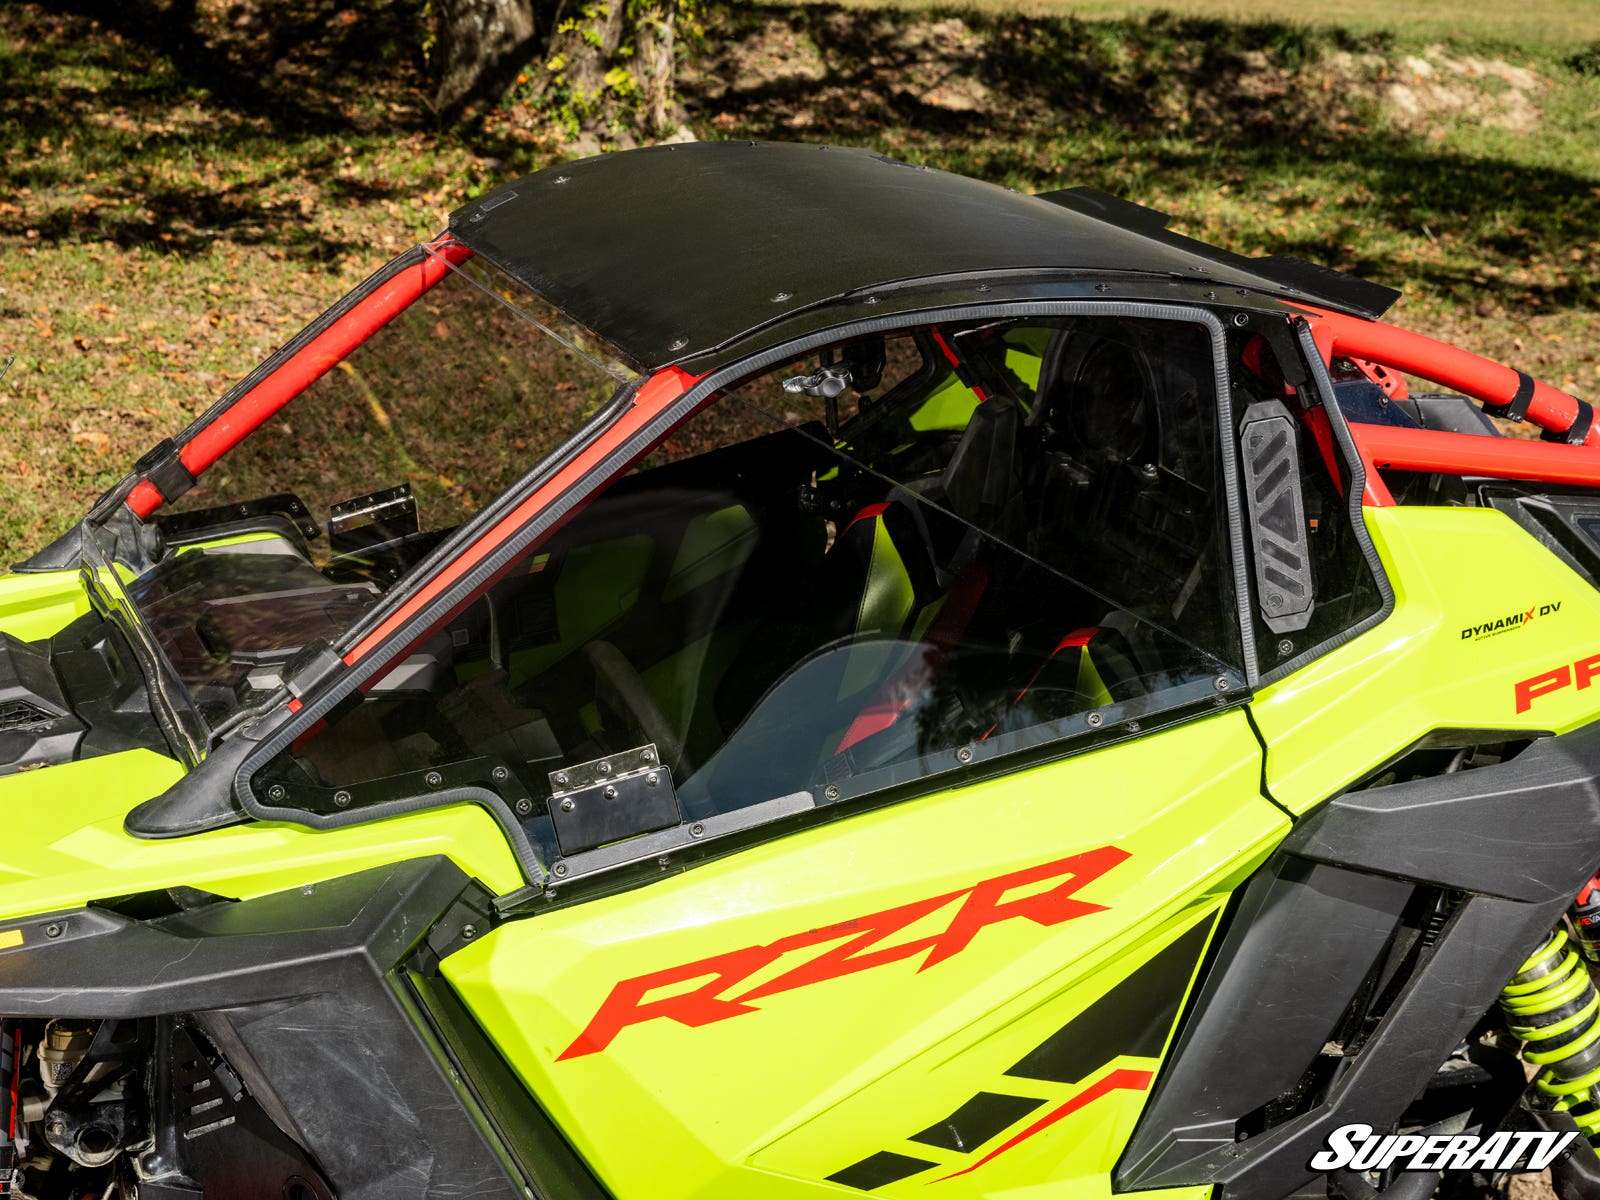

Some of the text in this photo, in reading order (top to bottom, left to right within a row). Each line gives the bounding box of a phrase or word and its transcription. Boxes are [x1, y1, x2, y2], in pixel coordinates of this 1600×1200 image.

[1461, 602, 1561, 640] DYNAMIX DV
[554, 846, 1132, 1061] RZR
